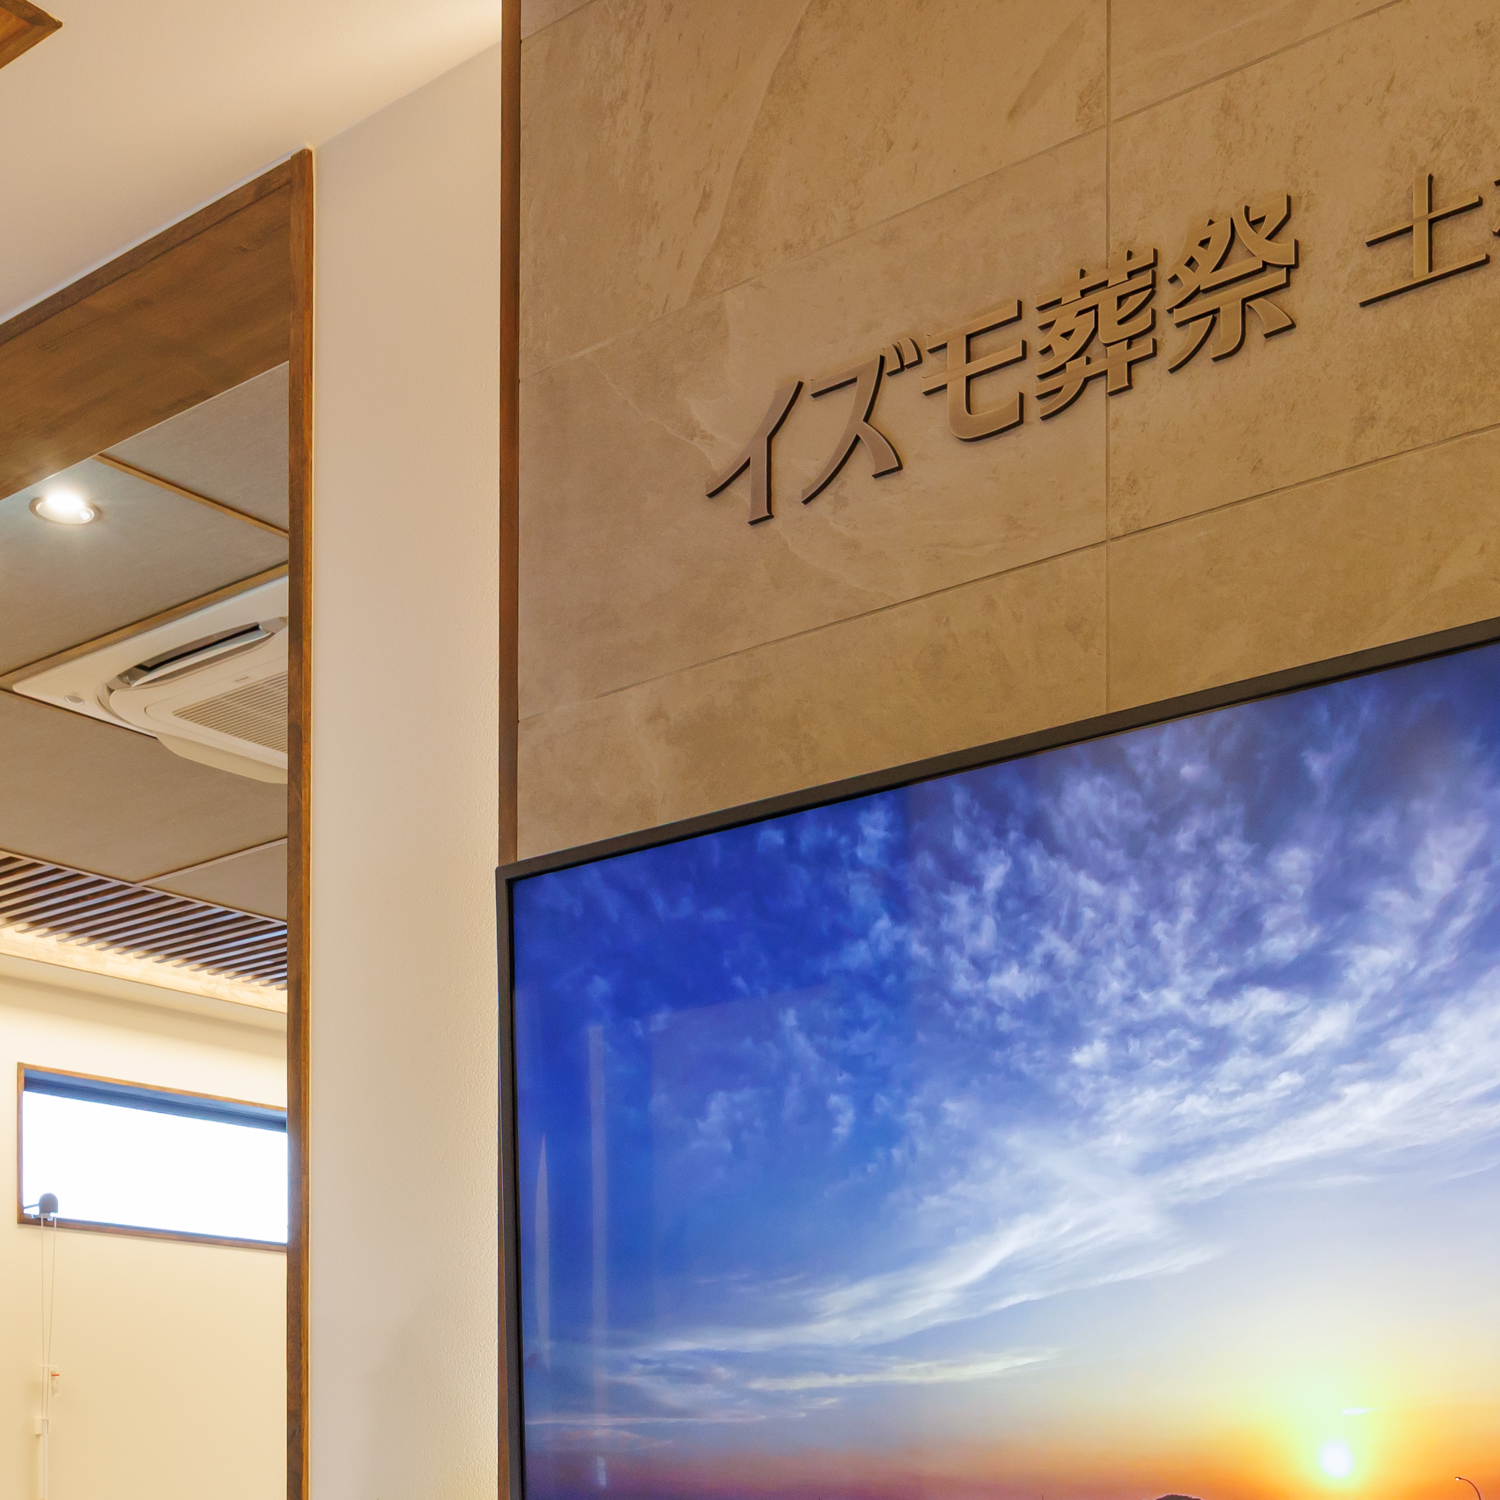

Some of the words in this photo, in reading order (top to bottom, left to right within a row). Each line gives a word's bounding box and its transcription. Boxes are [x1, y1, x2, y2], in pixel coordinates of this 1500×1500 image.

[705, 195, 1301, 525] イズモ葬祭
